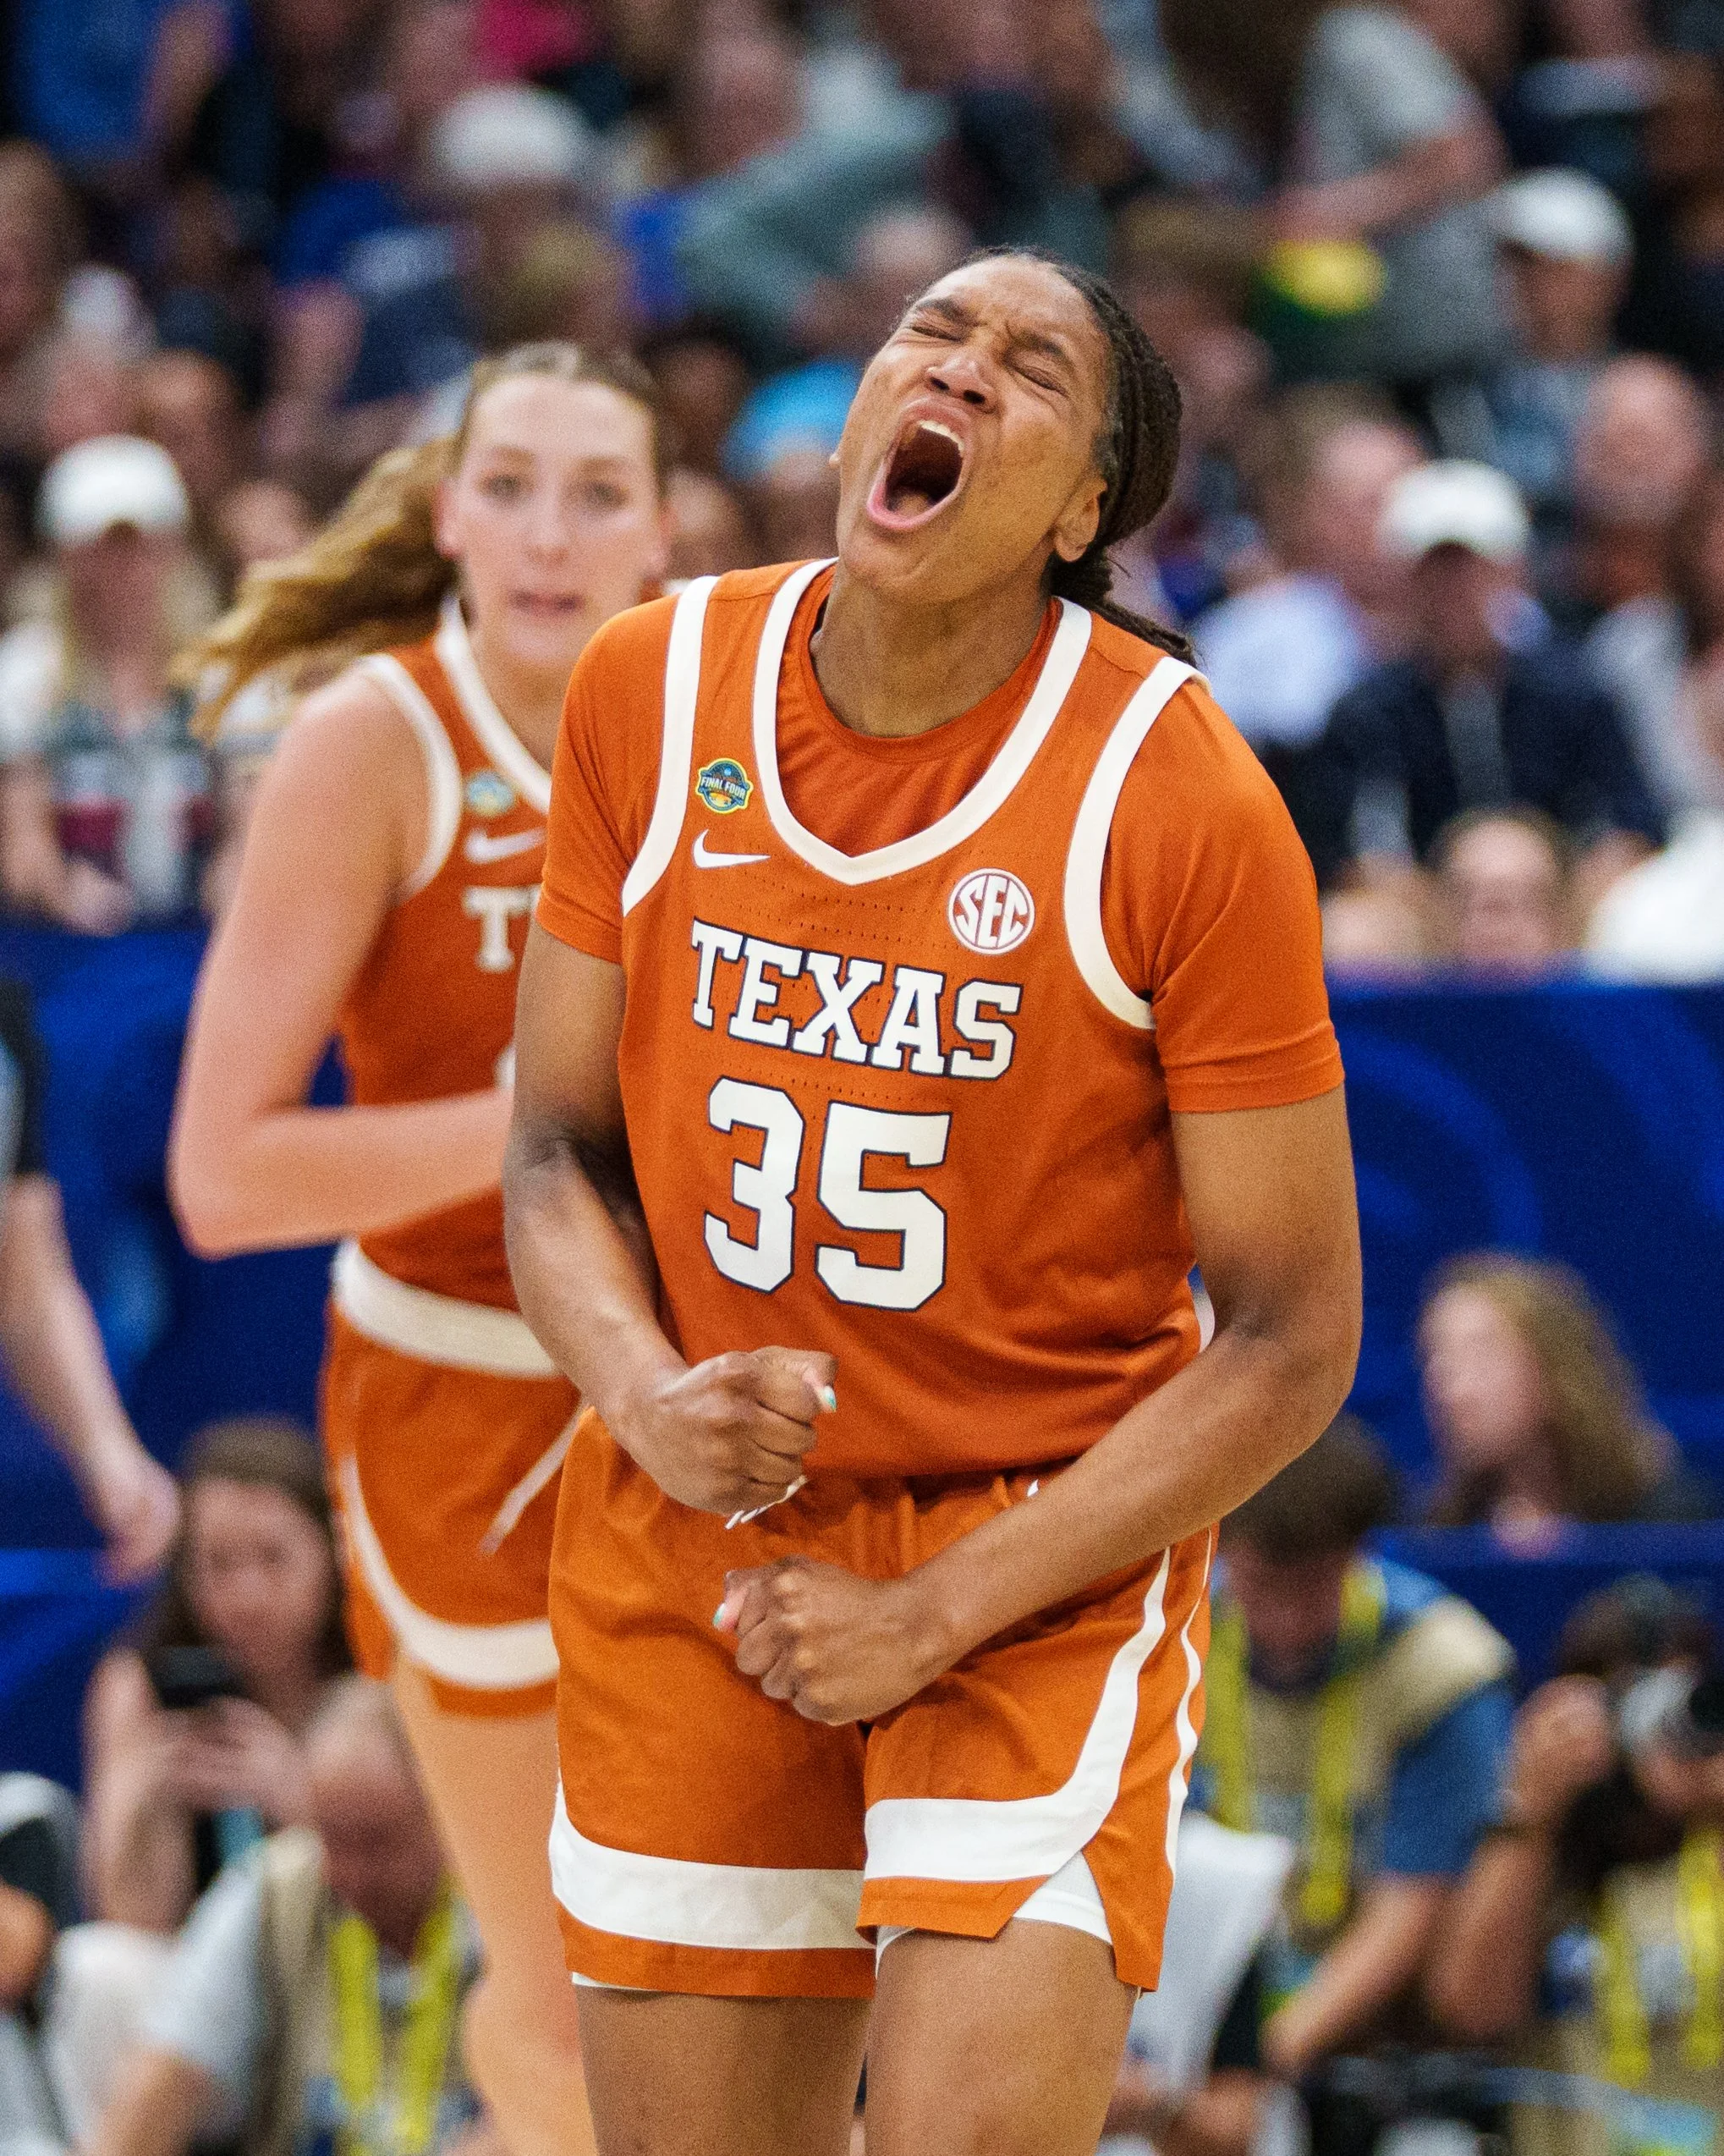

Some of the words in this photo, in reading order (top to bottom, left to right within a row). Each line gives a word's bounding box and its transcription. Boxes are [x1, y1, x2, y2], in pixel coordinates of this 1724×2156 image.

[700, 776, 723, 789] FINAL
[724, 781, 746, 799] FOUR
[955, 874, 1029, 949] SEC
[691, 918, 1022, 1081] TEXAS
[703, 1076, 952, 1312] 35
